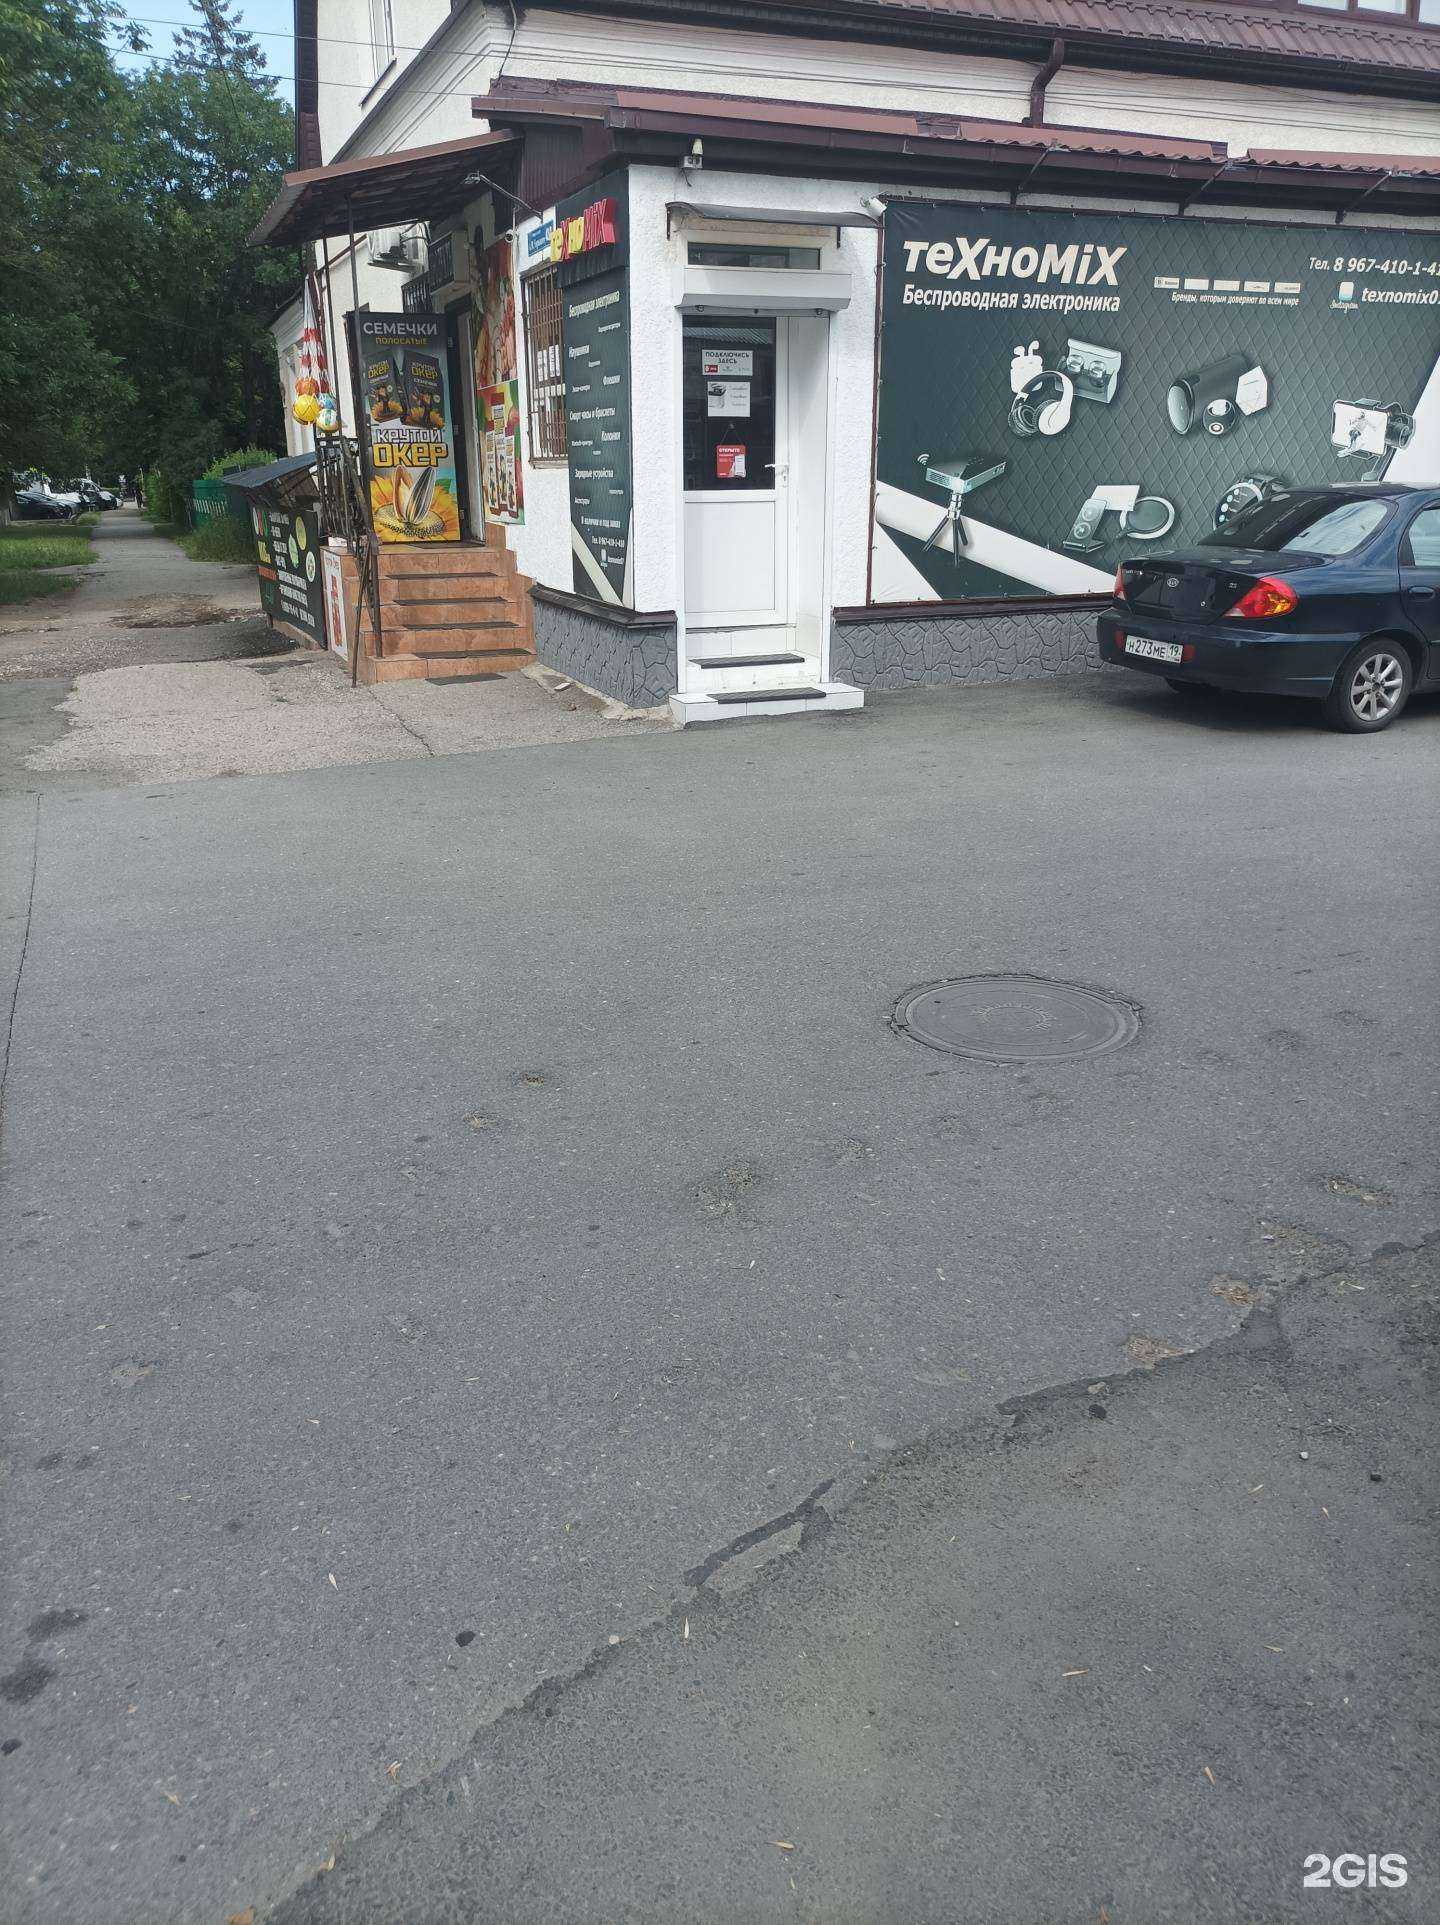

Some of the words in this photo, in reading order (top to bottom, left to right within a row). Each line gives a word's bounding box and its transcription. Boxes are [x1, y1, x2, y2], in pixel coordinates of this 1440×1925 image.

[1309, 257, 1330, 270] Тел.
[1333, 257, 1344, 272] 8
[903, 284, 1018, 311] Беспроводная
[1021, 292, 1121, 315] электроника
[1172, 292, 1198, 304] Бренды,
[1362, 288, 1440, 305] texnomix0
[363, 322, 438, 335] СЕМЕЧКИ
[375, 337, 428, 345] ПОЛОСАТЫЕ
[376, 428, 443, 443] КРУТОЙ
